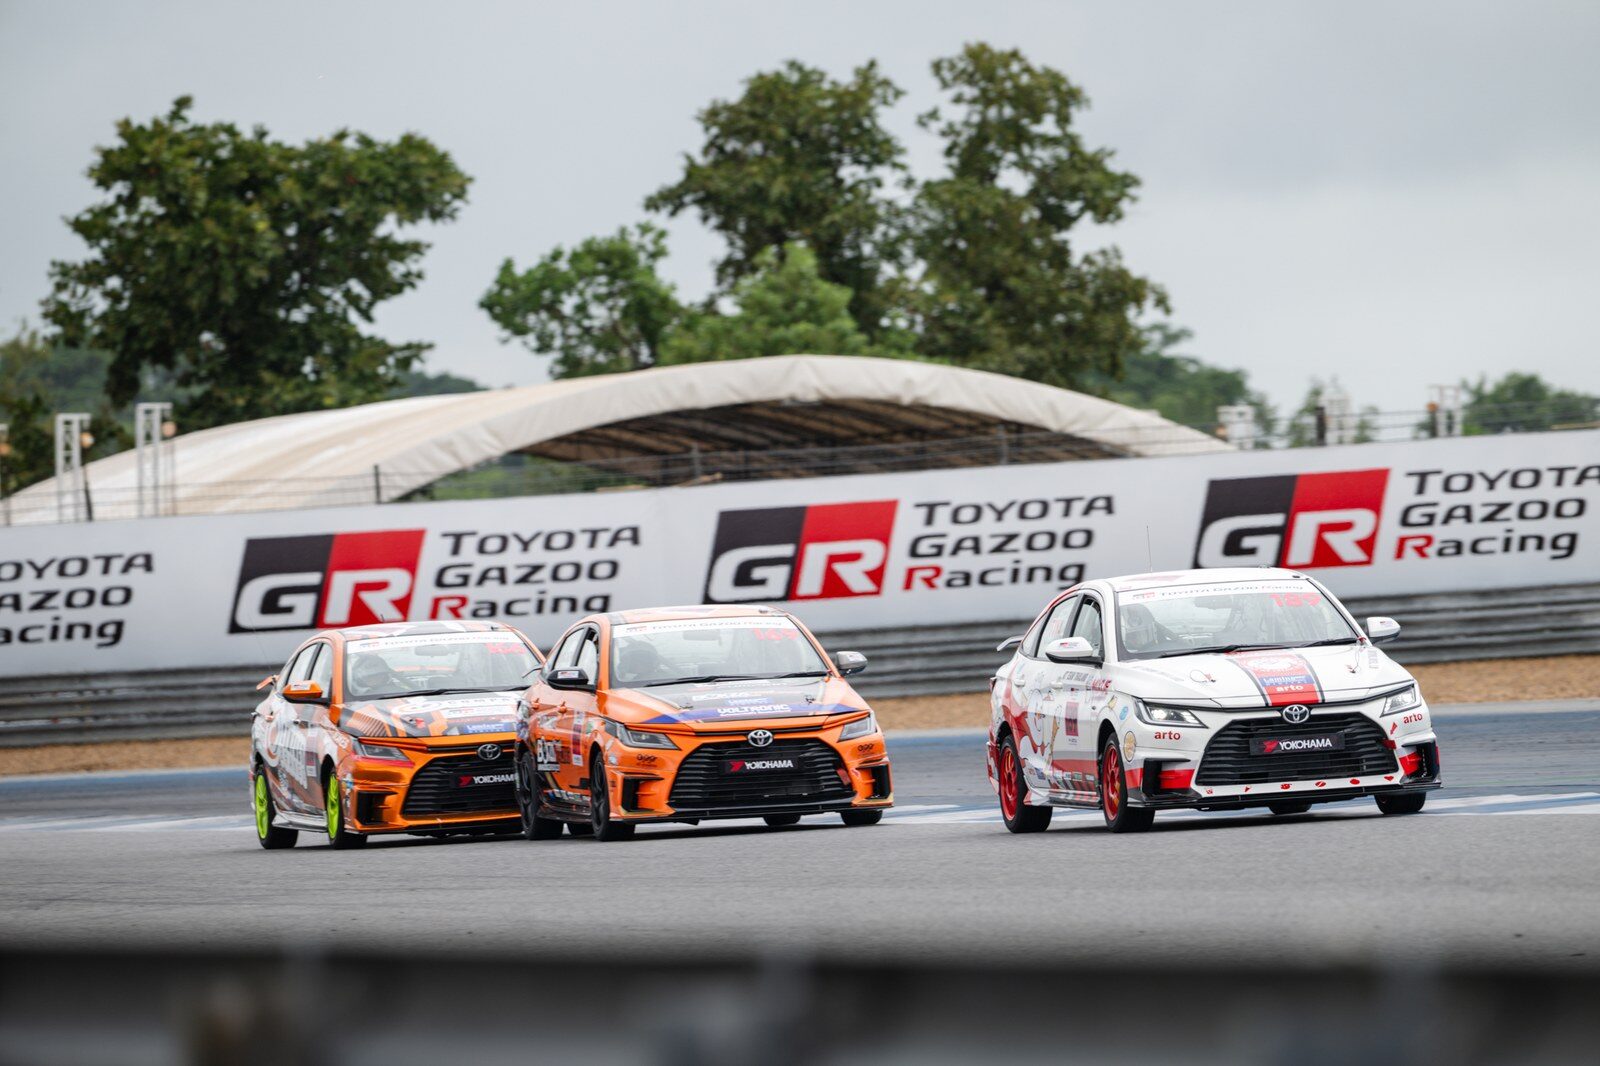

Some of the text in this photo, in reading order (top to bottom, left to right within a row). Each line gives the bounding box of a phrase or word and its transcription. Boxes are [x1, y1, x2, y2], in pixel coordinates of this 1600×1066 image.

[1406, 465, 1600, 496] TOYOTA
[913, 495, 1116, 527] TOYOTA
[1401, 498, 1587, 529] GAZOO
[441, 526, 641, 556] TOYOTA
[909, 528, 1094, 559] GAZOO
[1196, 508, 1377, 568] GR
[1393, 528, 1579, 560] Racing
[435, 559, 619, 589] GAZOO
[706, 539, 888, 602] GR
[902, 559, 1086, 592] Racing
[234, 568, 413, 628] GR
[1275, 684, 1304, 692] arto
[1403, 714, 1423, 724] arto
[1154, 729, 1181, 741] arto
[1279, 738, 1333, 751] YOKOHAMA
[473, 774, 516, 784] YOKOHAM
[744, 759, 794, 770] YOKOHAMA
